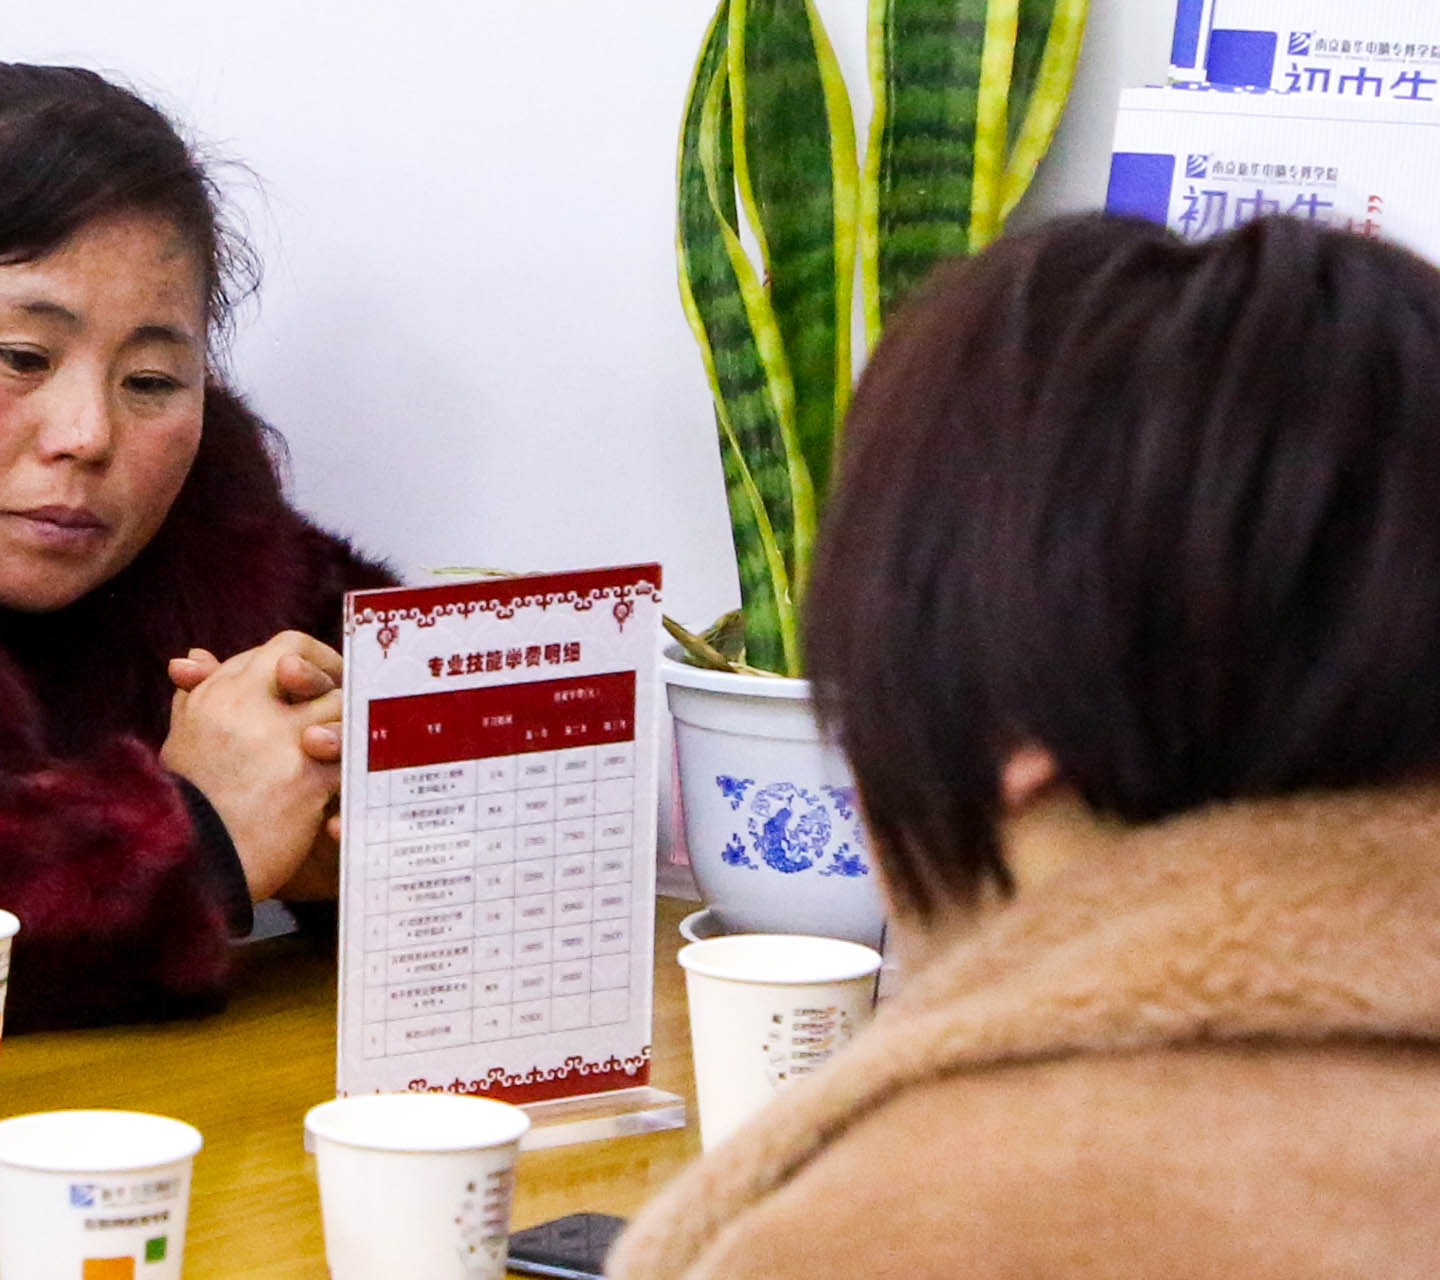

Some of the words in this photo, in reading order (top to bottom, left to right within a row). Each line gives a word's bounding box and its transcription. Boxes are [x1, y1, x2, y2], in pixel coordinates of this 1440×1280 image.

[427, 641, 582, 678] 专业技能学费明细
